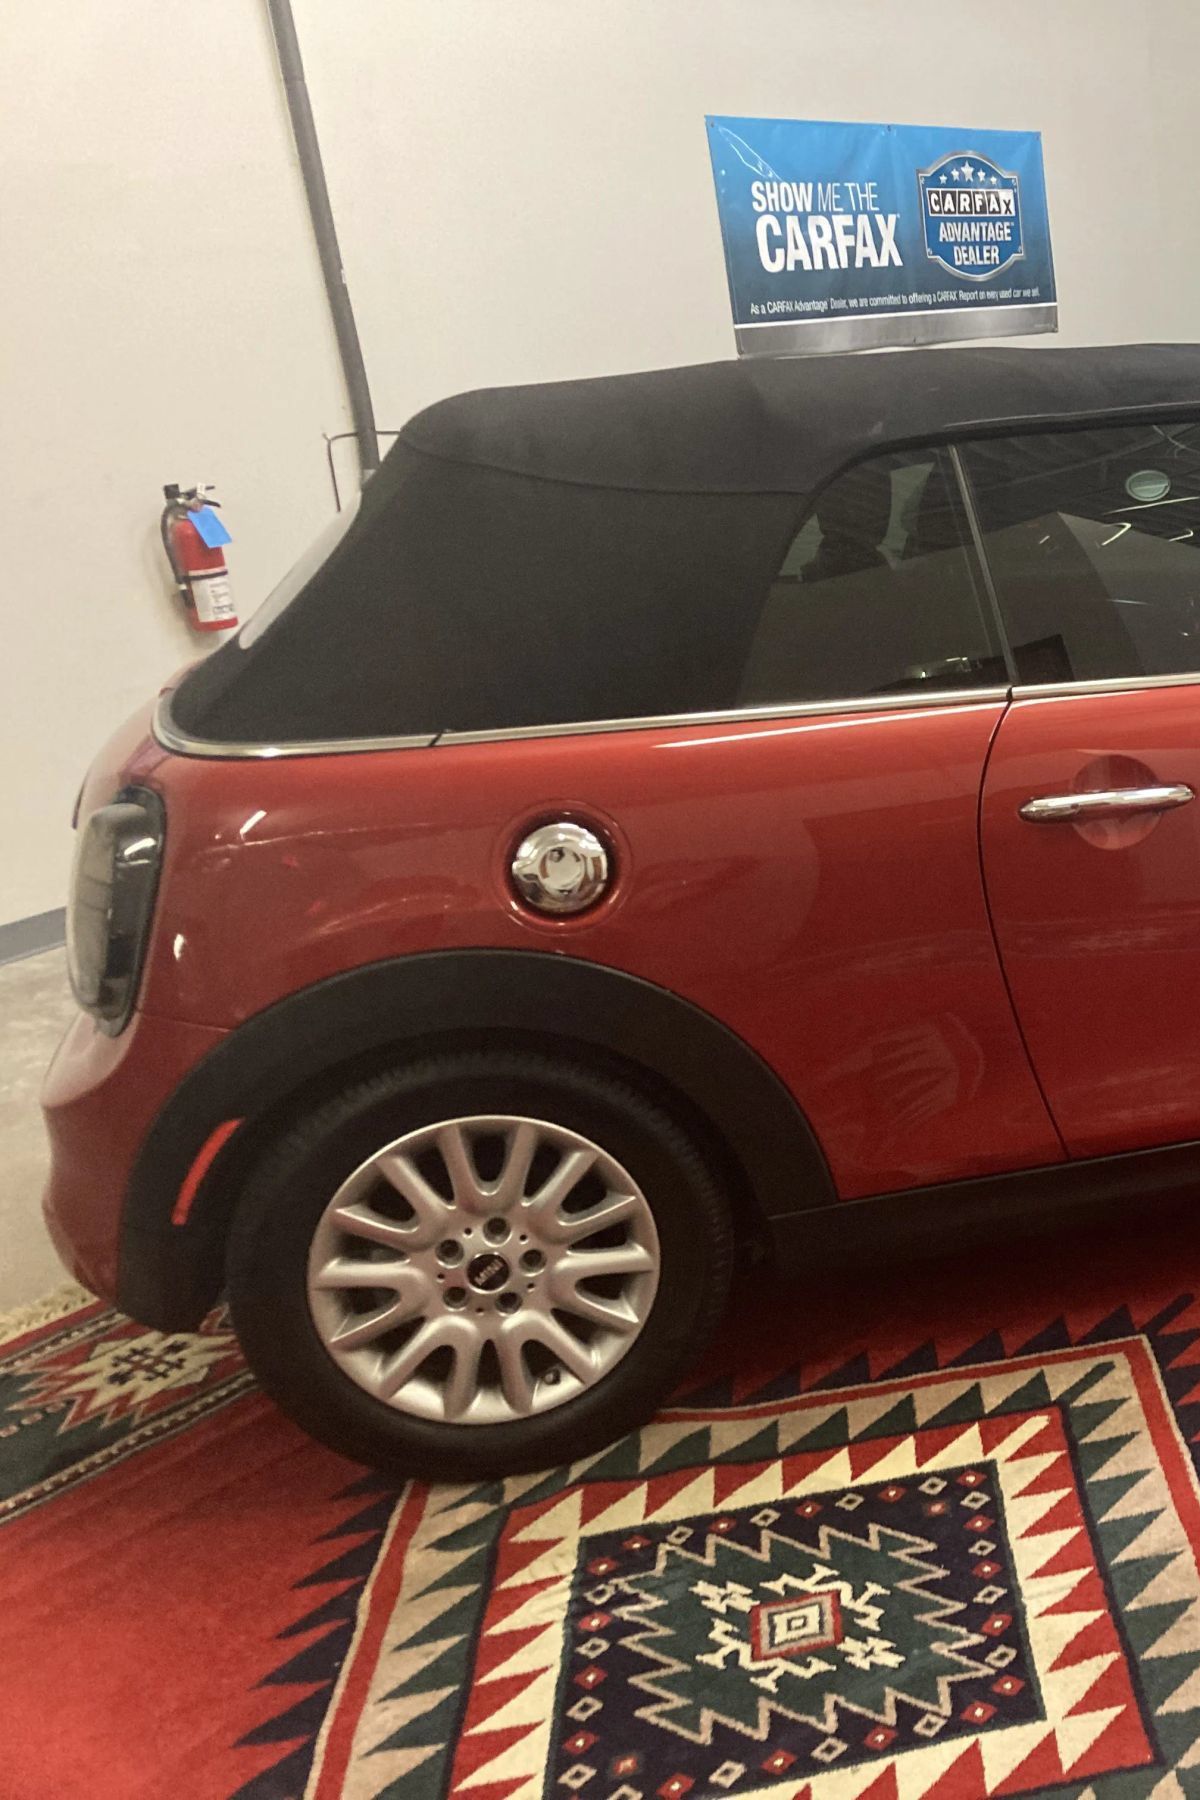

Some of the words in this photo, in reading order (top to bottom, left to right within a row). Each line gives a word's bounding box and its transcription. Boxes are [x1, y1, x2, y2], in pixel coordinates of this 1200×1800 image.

[751, 181, 813, 212] SHOW
[818, 182, 844, 212] ME
[844, 182, 880, 211] THE
[930, 192, 1013, 214] CARFAX
[756, 213, 904, 273] CARFAX
[939, 221, 1012, 243] ADVANTAGE
[953, 246, 1000, 266] DEALER
[750, 303, 760, 315] As
[760, 305, 766, 315] a
[767, 301, 794, 314] CARFAX
[794, 300, 829, 312] Advantage
[848, 299, 859, 308] we
[859, 298, 869, 308] are
[869, 294, 901, 306] committed
[902, 294, 908, 304] to
[908, 292, 932, 305] offering
[932, 294, 937, 303] a
[937, 290, 958, 302] CARFAX
[959, 290, 978, 302] Report
[979, 291, 986, 301] on
[999, 288, 1012, 299] used
[1012, 288, 1023, 298] car
